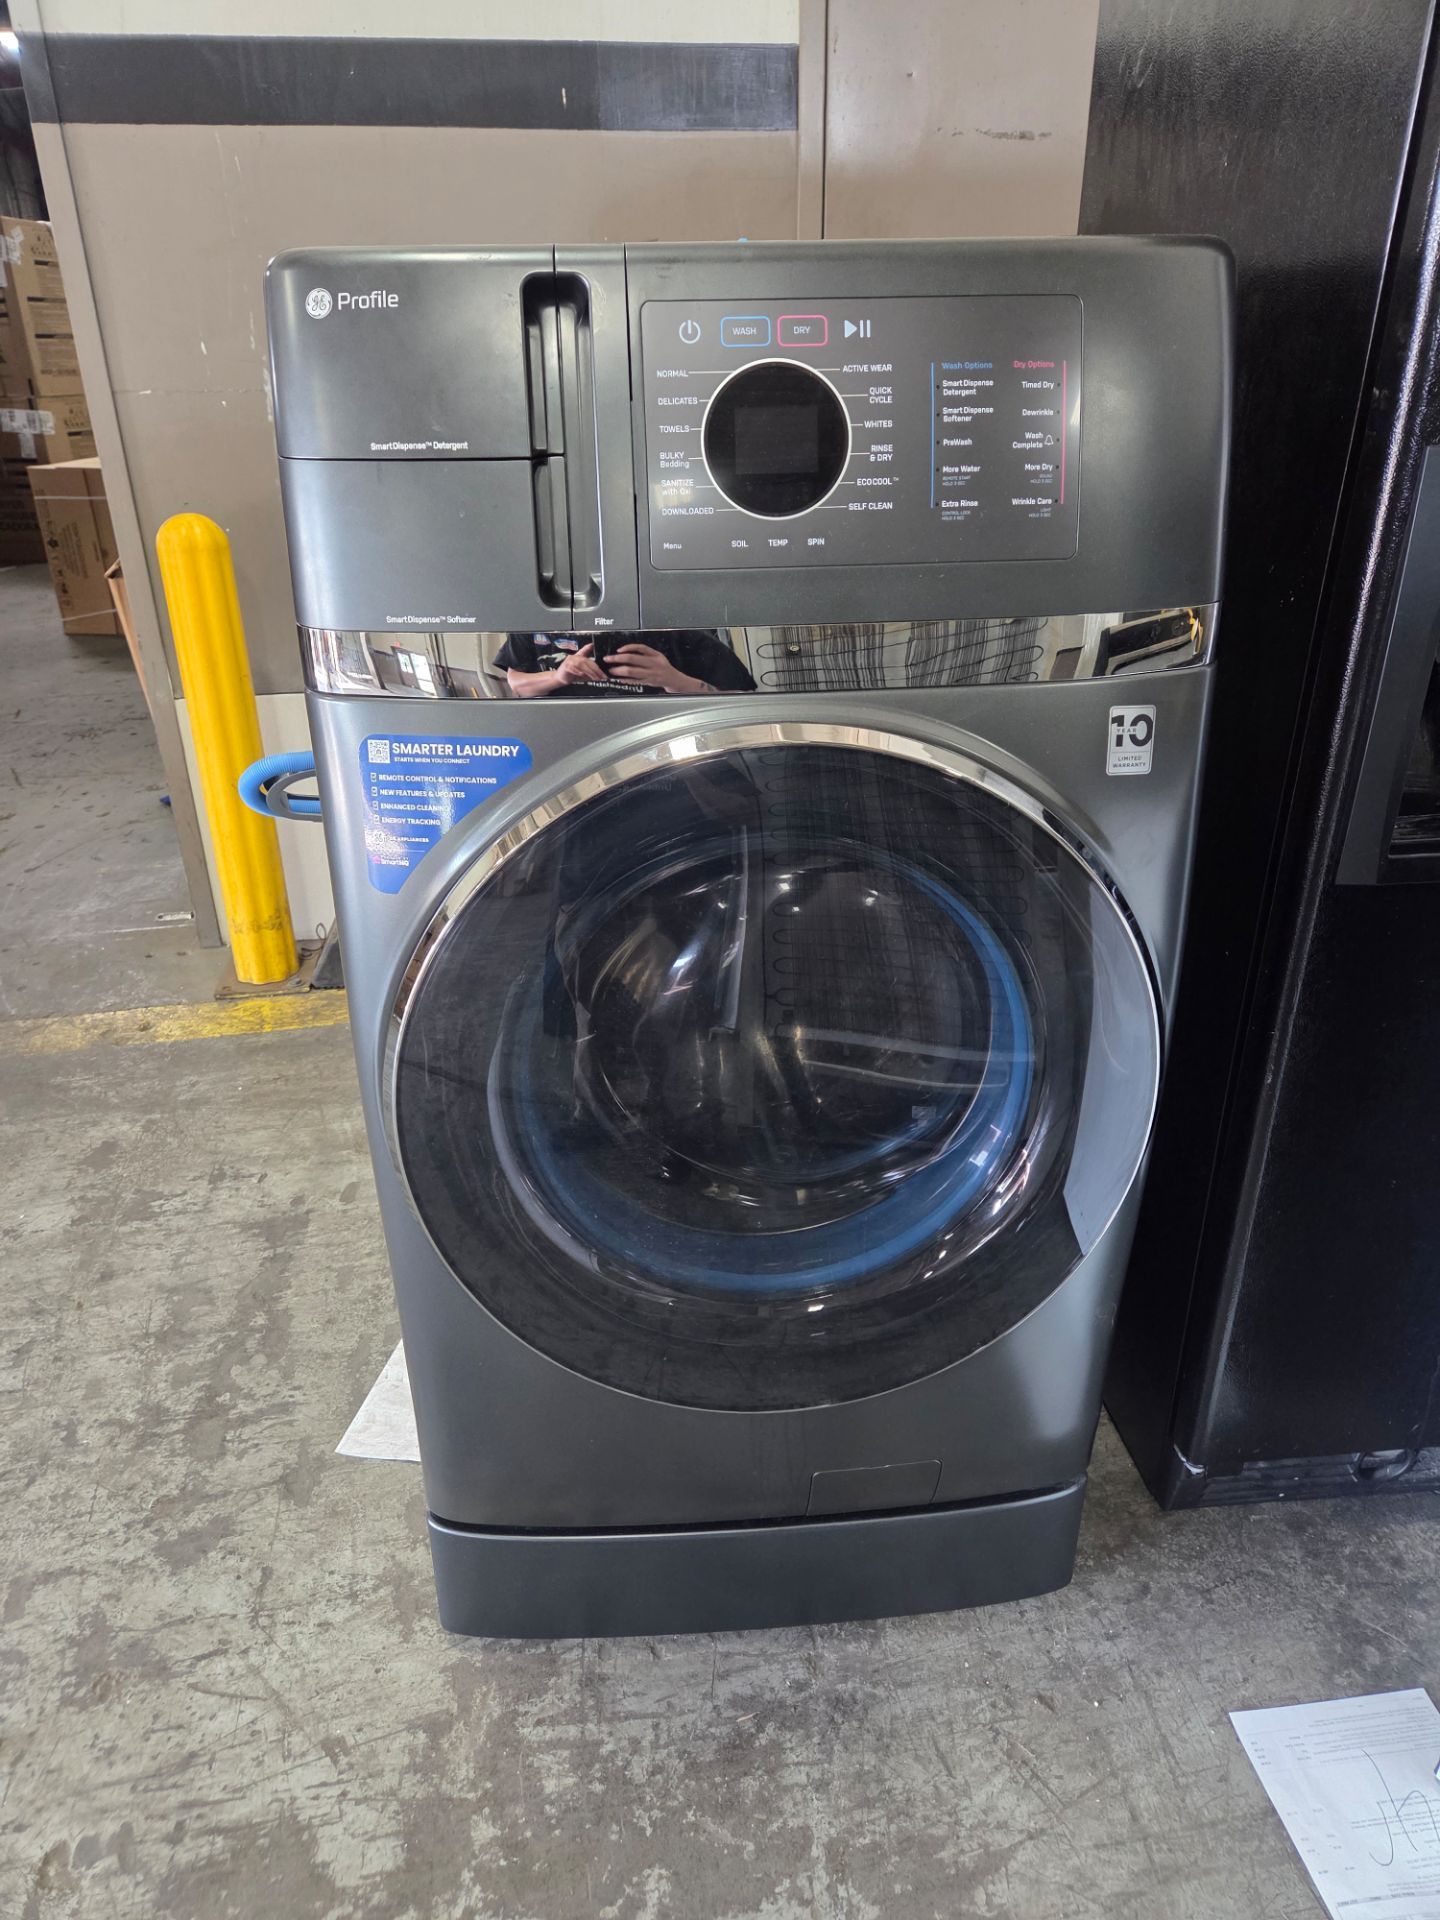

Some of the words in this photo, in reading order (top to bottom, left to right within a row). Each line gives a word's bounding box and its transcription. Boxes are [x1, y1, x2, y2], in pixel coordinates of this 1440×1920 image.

[337, 290, 399, 310] Profile
[732, 326, 757, 336] WASH
[793, 325, 811, 335] DRY
[842, 364, 869, 373] ACTIVE
[870, 363, 893, 372] WEAR
[941, 361, 962, 369] Wash
[964, 361, 993, 370] Options
[1013, 360, 1026, 369] Dry
[1027, 360, 1055, 370] Options
[656, 369, 688, 378] NORMAL
[1021, 381, 1042, 389] Timed
[1042, 381, 1055, 389] Dry
[869, 386, 893, 395] QUICK
[943, 388, 977, 397] Detergent
[658, 396, 698, 405] DELICATES
[869, 396, 893, 404] CYCLE
[1022, 408, 1054, 416] Dewrinkle
[943, 415, 973, 423] Softener
[659, 424, 690, 433] TOWELS
[864, 420, 893, 428] WHITES
[1024, 431, 1043, 440] Wash
[433, 441, 469, 451] Detergent
[943, 437, 973, 446] PreWash
[1012, 441, 1043, 450] Complete
[871, 444, 893, 452] RINSE
[659, 451, 684, 460] BULKY
[877, 453, 893, 461] DRY
[660, 460, 690, 469] Bedding
[942, 465, 959, 473] More
[960, 465, 981, 473] Water
[1024, 463, 1041, 471] More
[1041, 463, 1053, 472] Dry
[661, 479, 694, 487] SANITIZE
[662, 487, 678, 496] with
[848, 502, 867, 511] SELF
[868, 501, 893, 510] CLEAN
[941, 500, 959, 508] Extra
[960, 499, 979, 507] Rinse
[1011, 497, 1036, 506] Wrinkle
[1037, 497, 1052, 505] Care
[661, 507, 714, 516] DOWNLOADED
[663, 542, 682, 550] Menu
[731, 539, 749, 548] SOIL
[767, 538, 788, 547] TEMP
[807, 537, 825, 546] SPIN
[446, 615, 477, 624] Softener
[594, 616, 614, 626] Filter
[1111, 713, 1154, 747] 10
[392, 742, 453, 756] SMARTER
[456, 744, 519, 757] LAUNDRY
[396, 789, 427, 797] FEATURES
[381, 816, 406, 824] ENERGY
[406, 818, 441, 826] TRACKING
